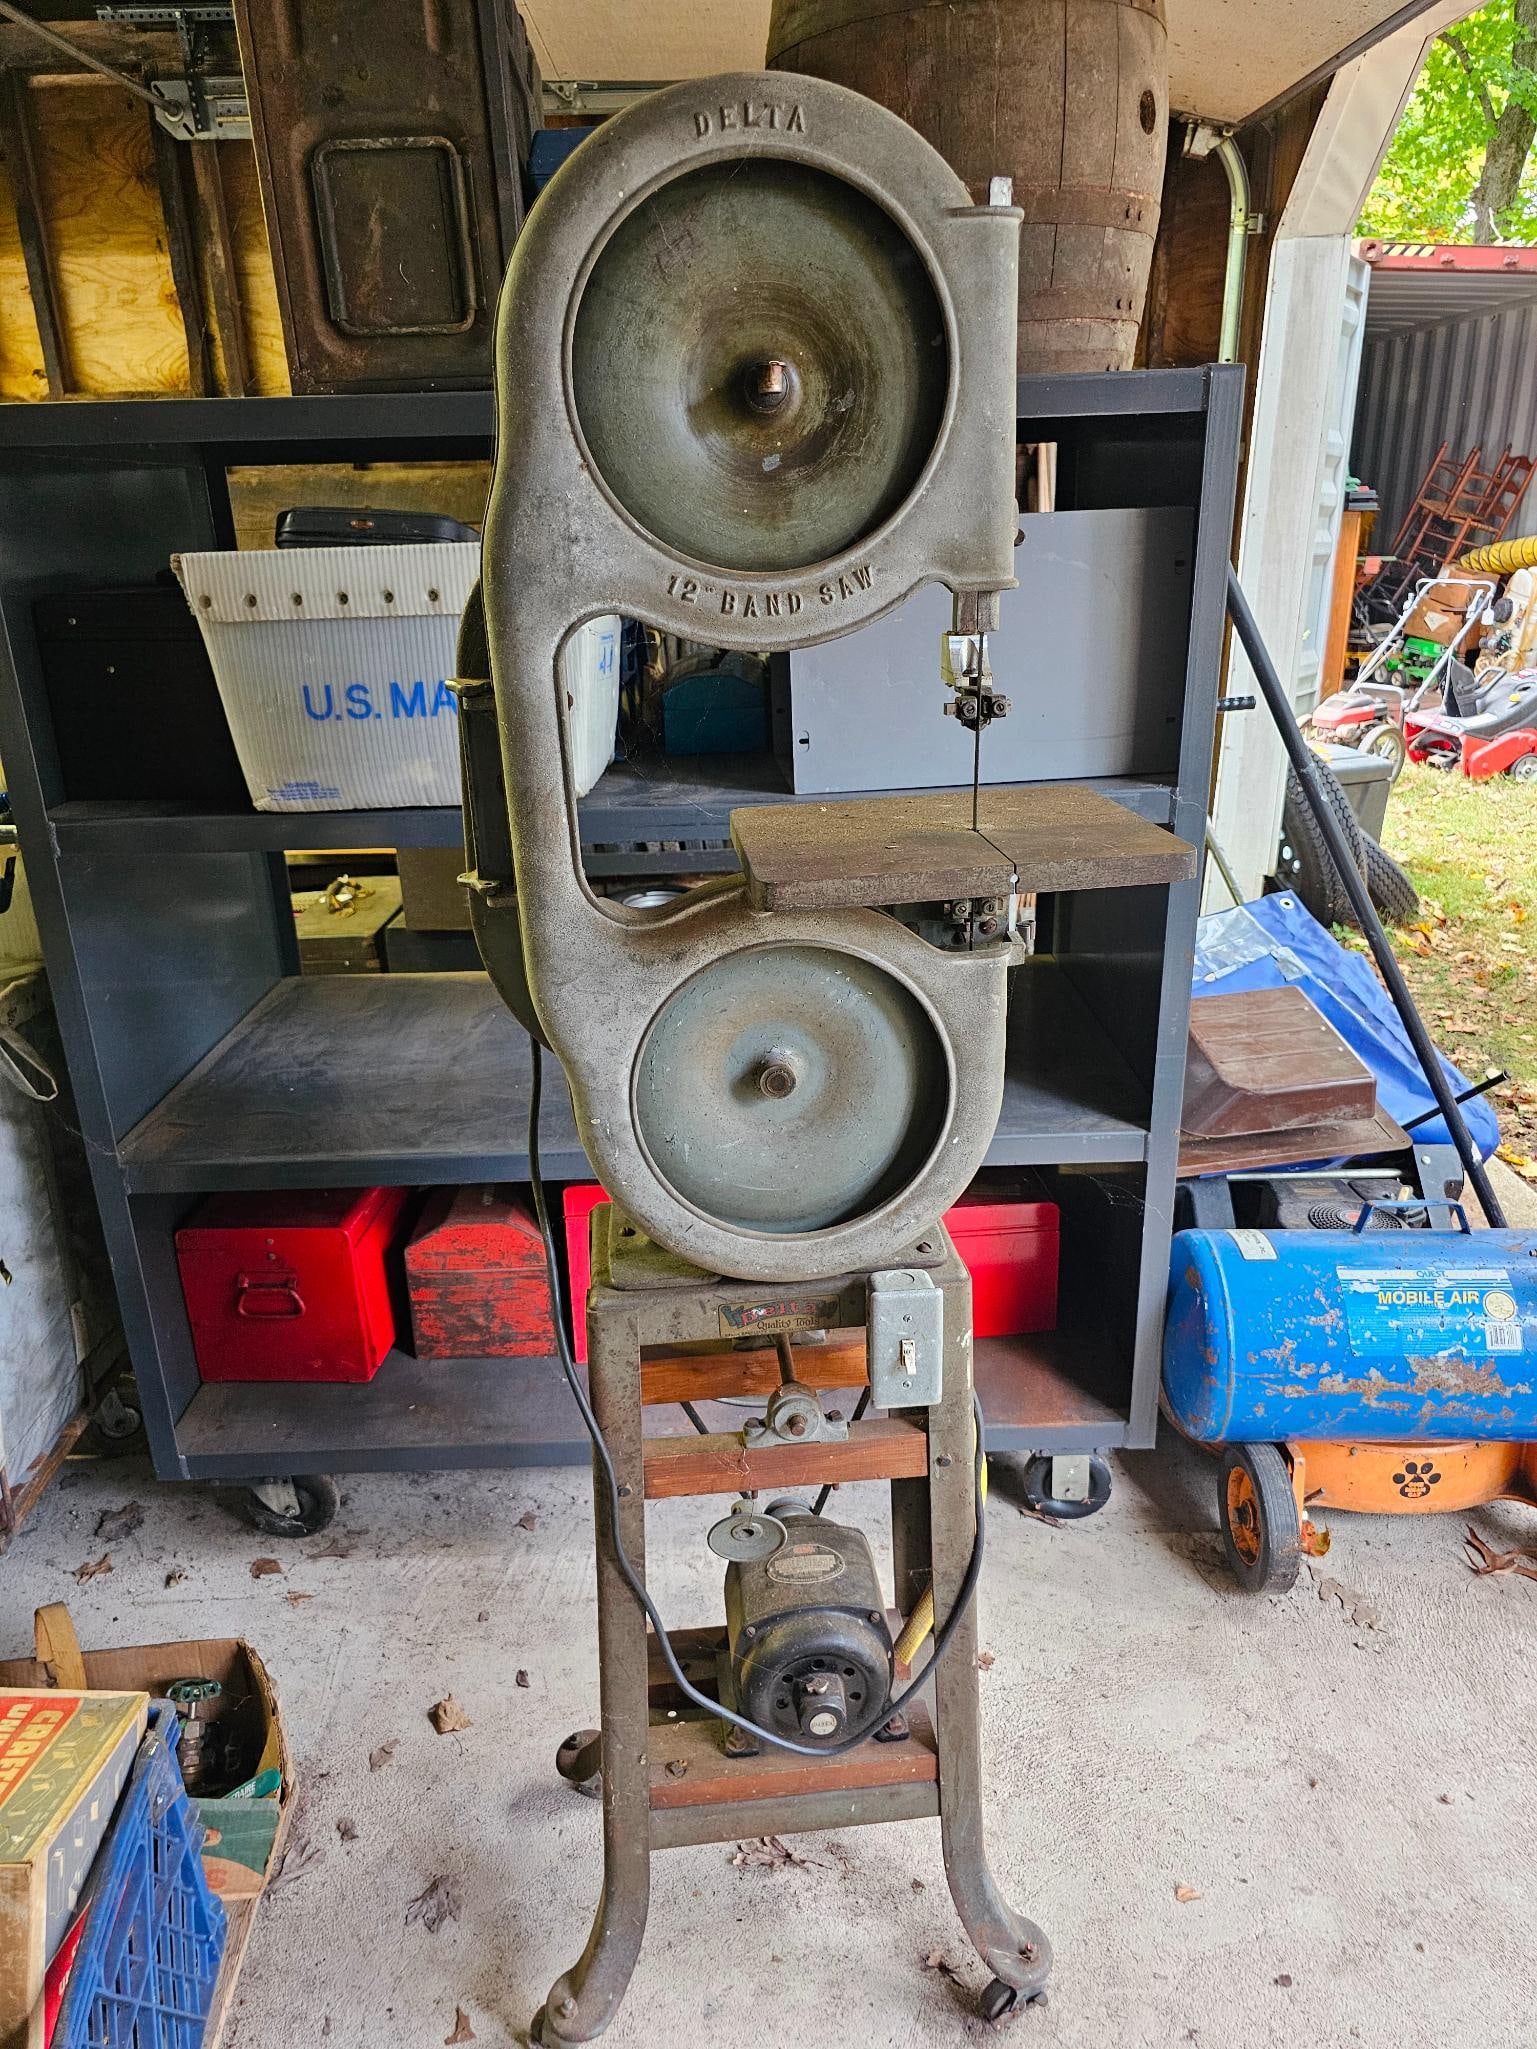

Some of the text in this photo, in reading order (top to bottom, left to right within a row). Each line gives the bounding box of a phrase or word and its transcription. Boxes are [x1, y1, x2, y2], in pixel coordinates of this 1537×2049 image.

[693, 101, 806, 138] DELTA
[720, 589, 804, 618] BAND
[818, 564, 875, 606] SAW
[302, 683, 383, 722] U.S.
[1378, 1290, 1481, 1305] MOBILE AIR
[757, 1317, 820, 1331] Quality Tools
